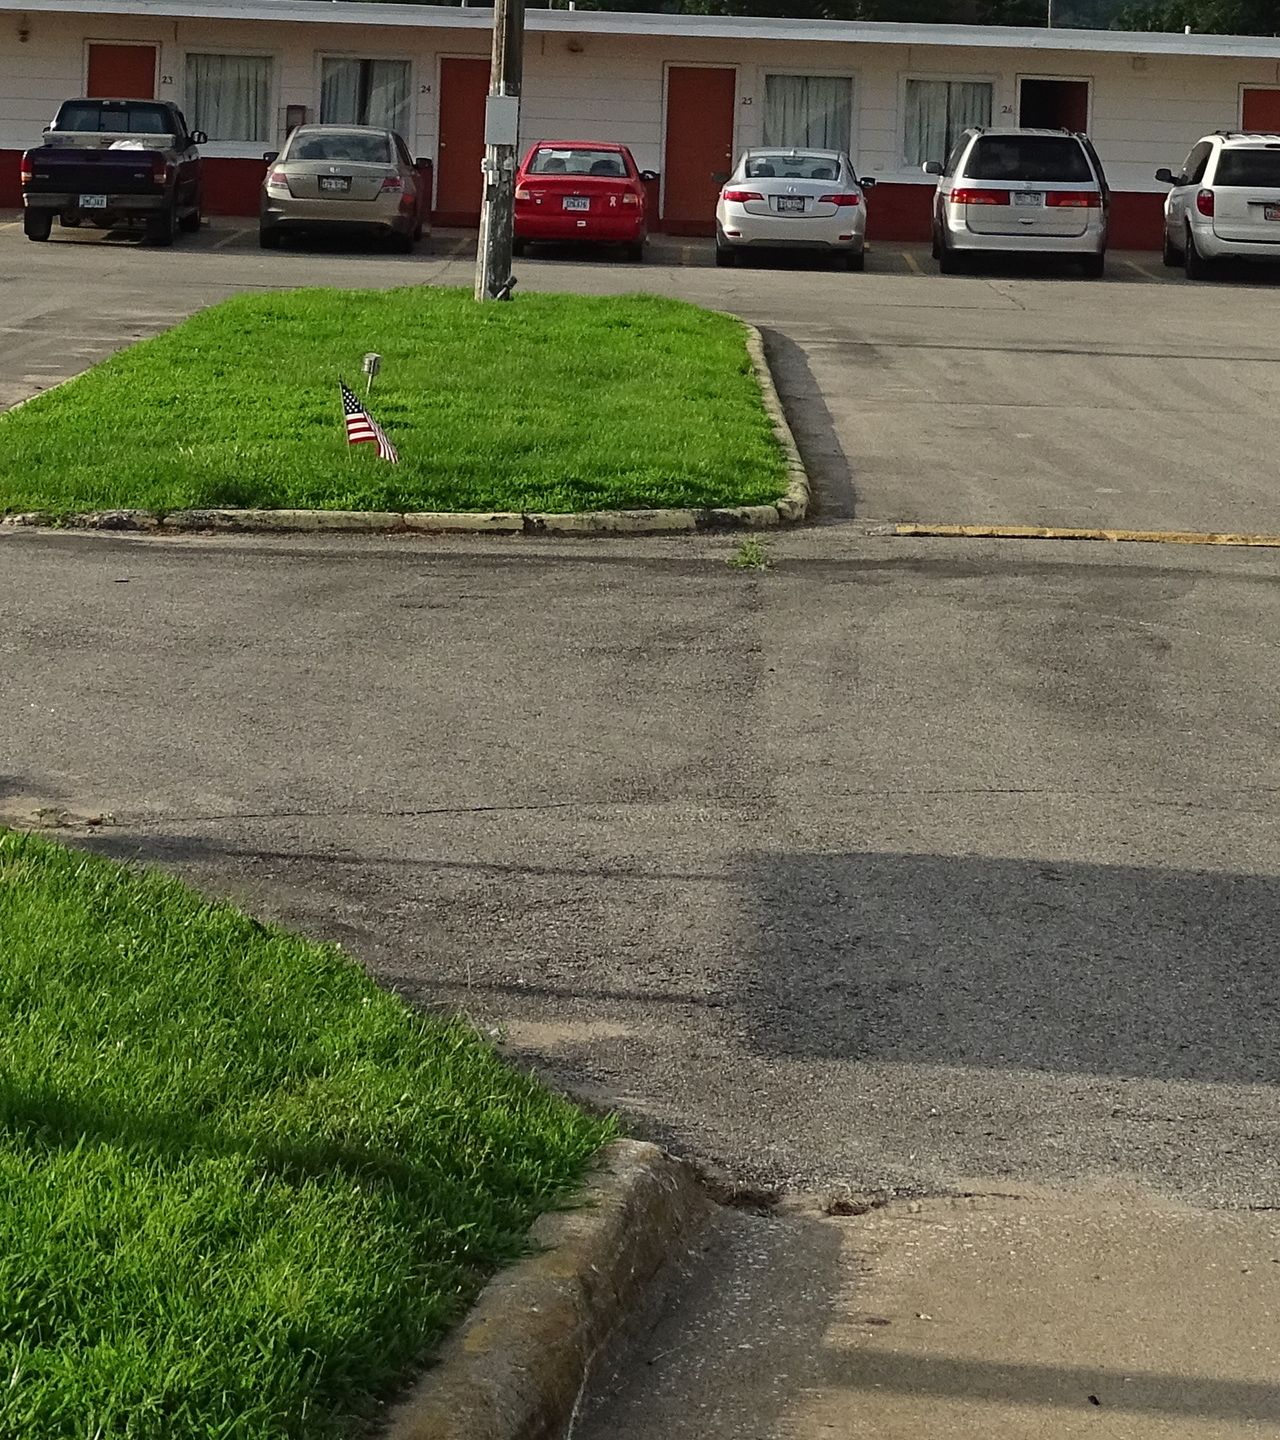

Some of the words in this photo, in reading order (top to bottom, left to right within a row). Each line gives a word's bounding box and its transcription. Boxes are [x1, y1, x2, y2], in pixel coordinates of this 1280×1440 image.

[162, 75, 173, 84] 23
[421, 85, 431, 94] 24
[742, 97, 753, 105] 25
[1002, 105, 1013, 113] 26
